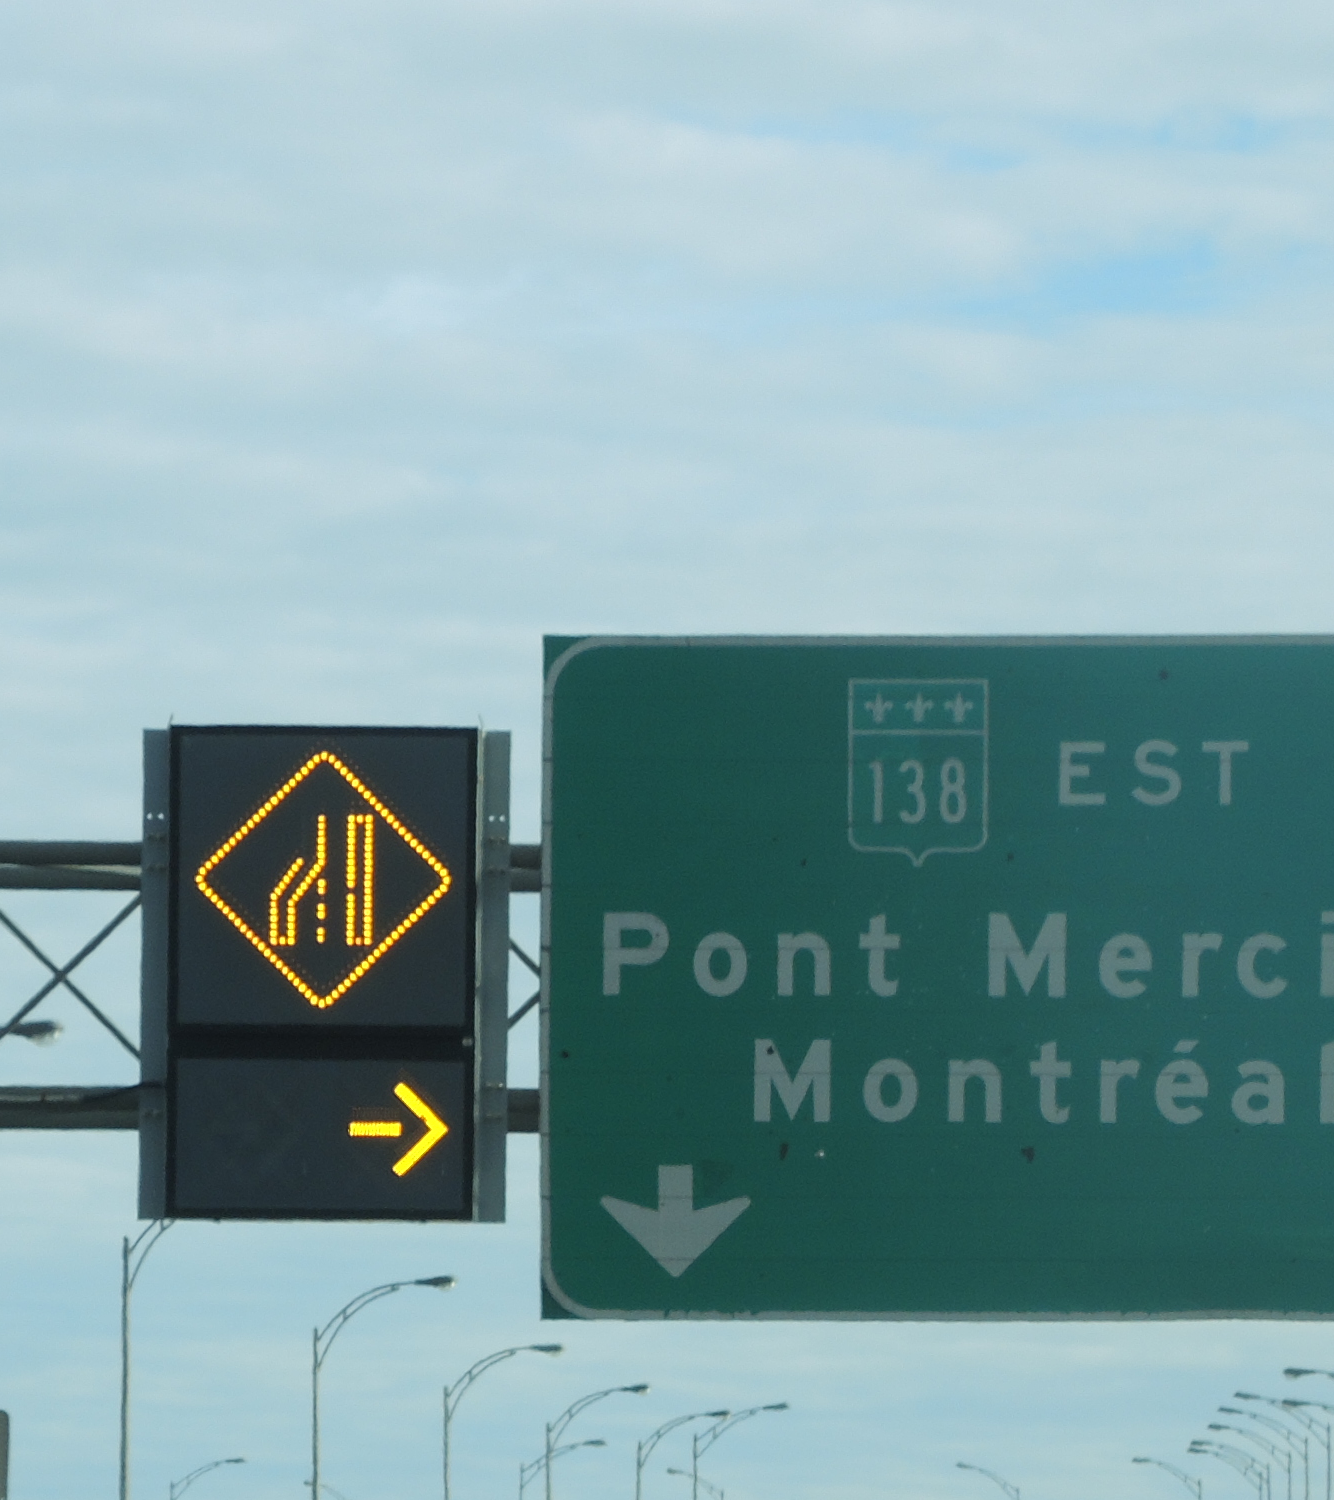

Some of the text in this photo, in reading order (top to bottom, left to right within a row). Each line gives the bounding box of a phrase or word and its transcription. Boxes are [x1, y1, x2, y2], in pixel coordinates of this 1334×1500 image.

[868, 741, 1250, 823] 138 EST
[603, 911, 901, 998] Pont
